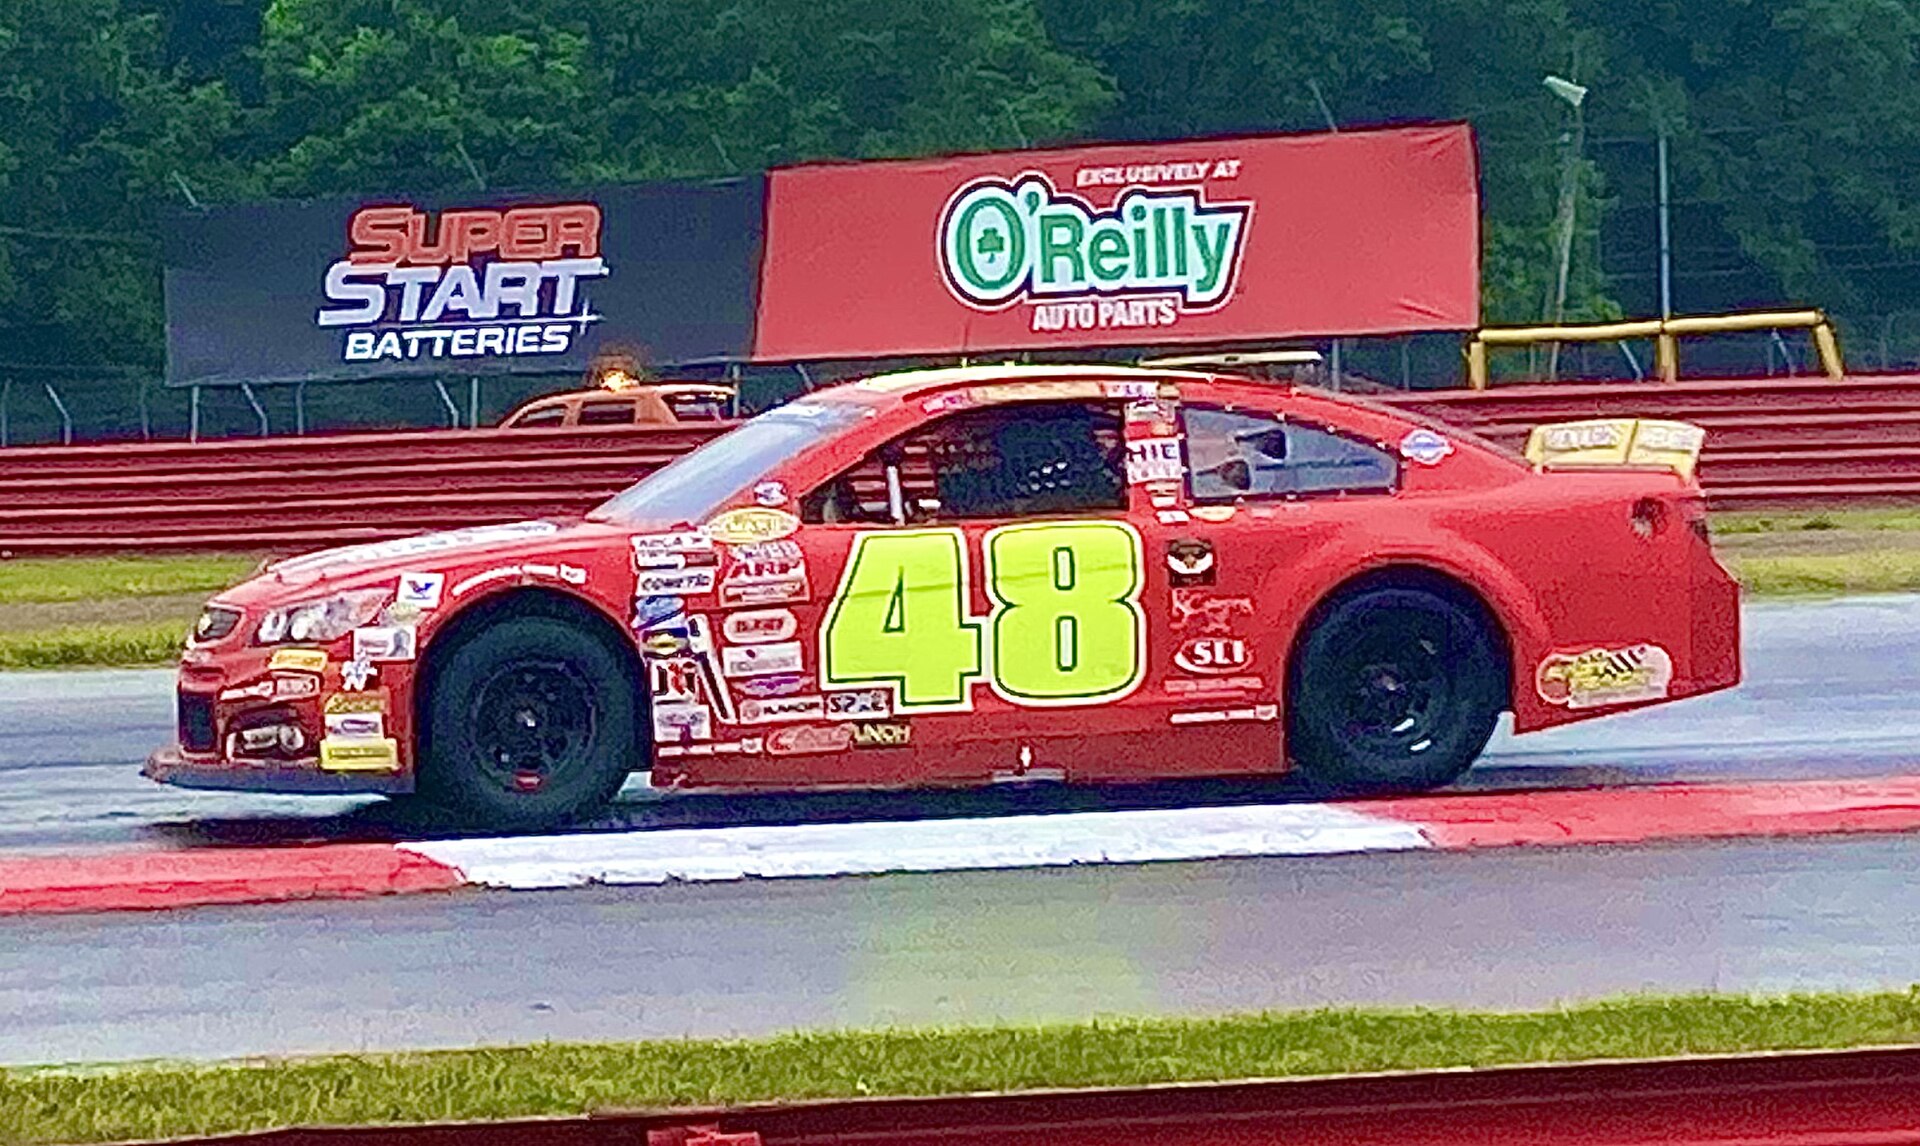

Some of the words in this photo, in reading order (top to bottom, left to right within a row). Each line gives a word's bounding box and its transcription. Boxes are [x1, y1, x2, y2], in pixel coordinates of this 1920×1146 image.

[1076, 162, 1209, 187] EXCLUSIVELY
[1212, 159, 1241, 178] AT
[349, 204, 601, 265] SUPER
[955, 190, 1231, 292] O'Reilly
[318, 258, 609, 326] START
[1033, 304, 1095, 331] AUTO
[1099, 300, 1178, 326] PARTS
[345, 324, 573, 360] BATTERIES
[822, 522, 1143, 710] 48
